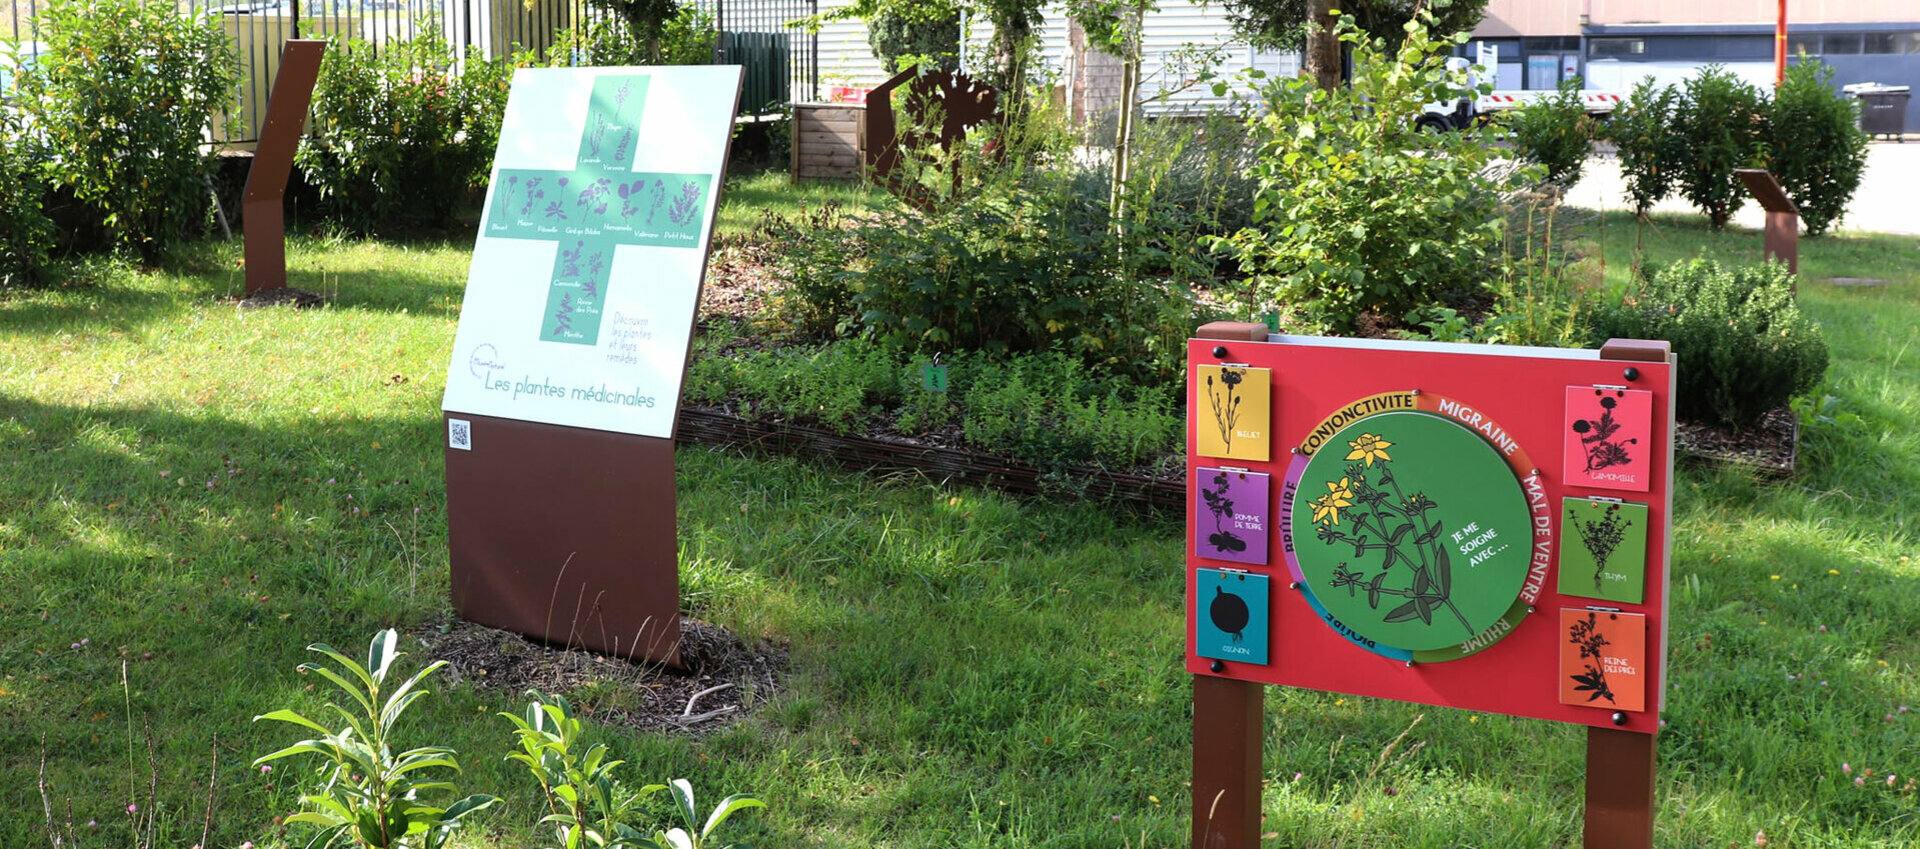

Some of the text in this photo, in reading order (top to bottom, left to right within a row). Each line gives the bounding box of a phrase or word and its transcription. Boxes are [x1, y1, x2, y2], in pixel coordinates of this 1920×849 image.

[484, 370, 656, 408] Les plantes médicinales
[1301, 394, 1413, 457] CONJONCTIVITE
[1438, 398, 1519, 456] MIGRAINE
[1450, 522, 1480, 544] JE ME
[1460, 528, 1498, 555] SOIGNE
[1520, 476, 1551, 604] MAL DE VENTRE
[1469, 546, 1496, 568] AVEC
[1460, 618, 1512, 654] RHUME
